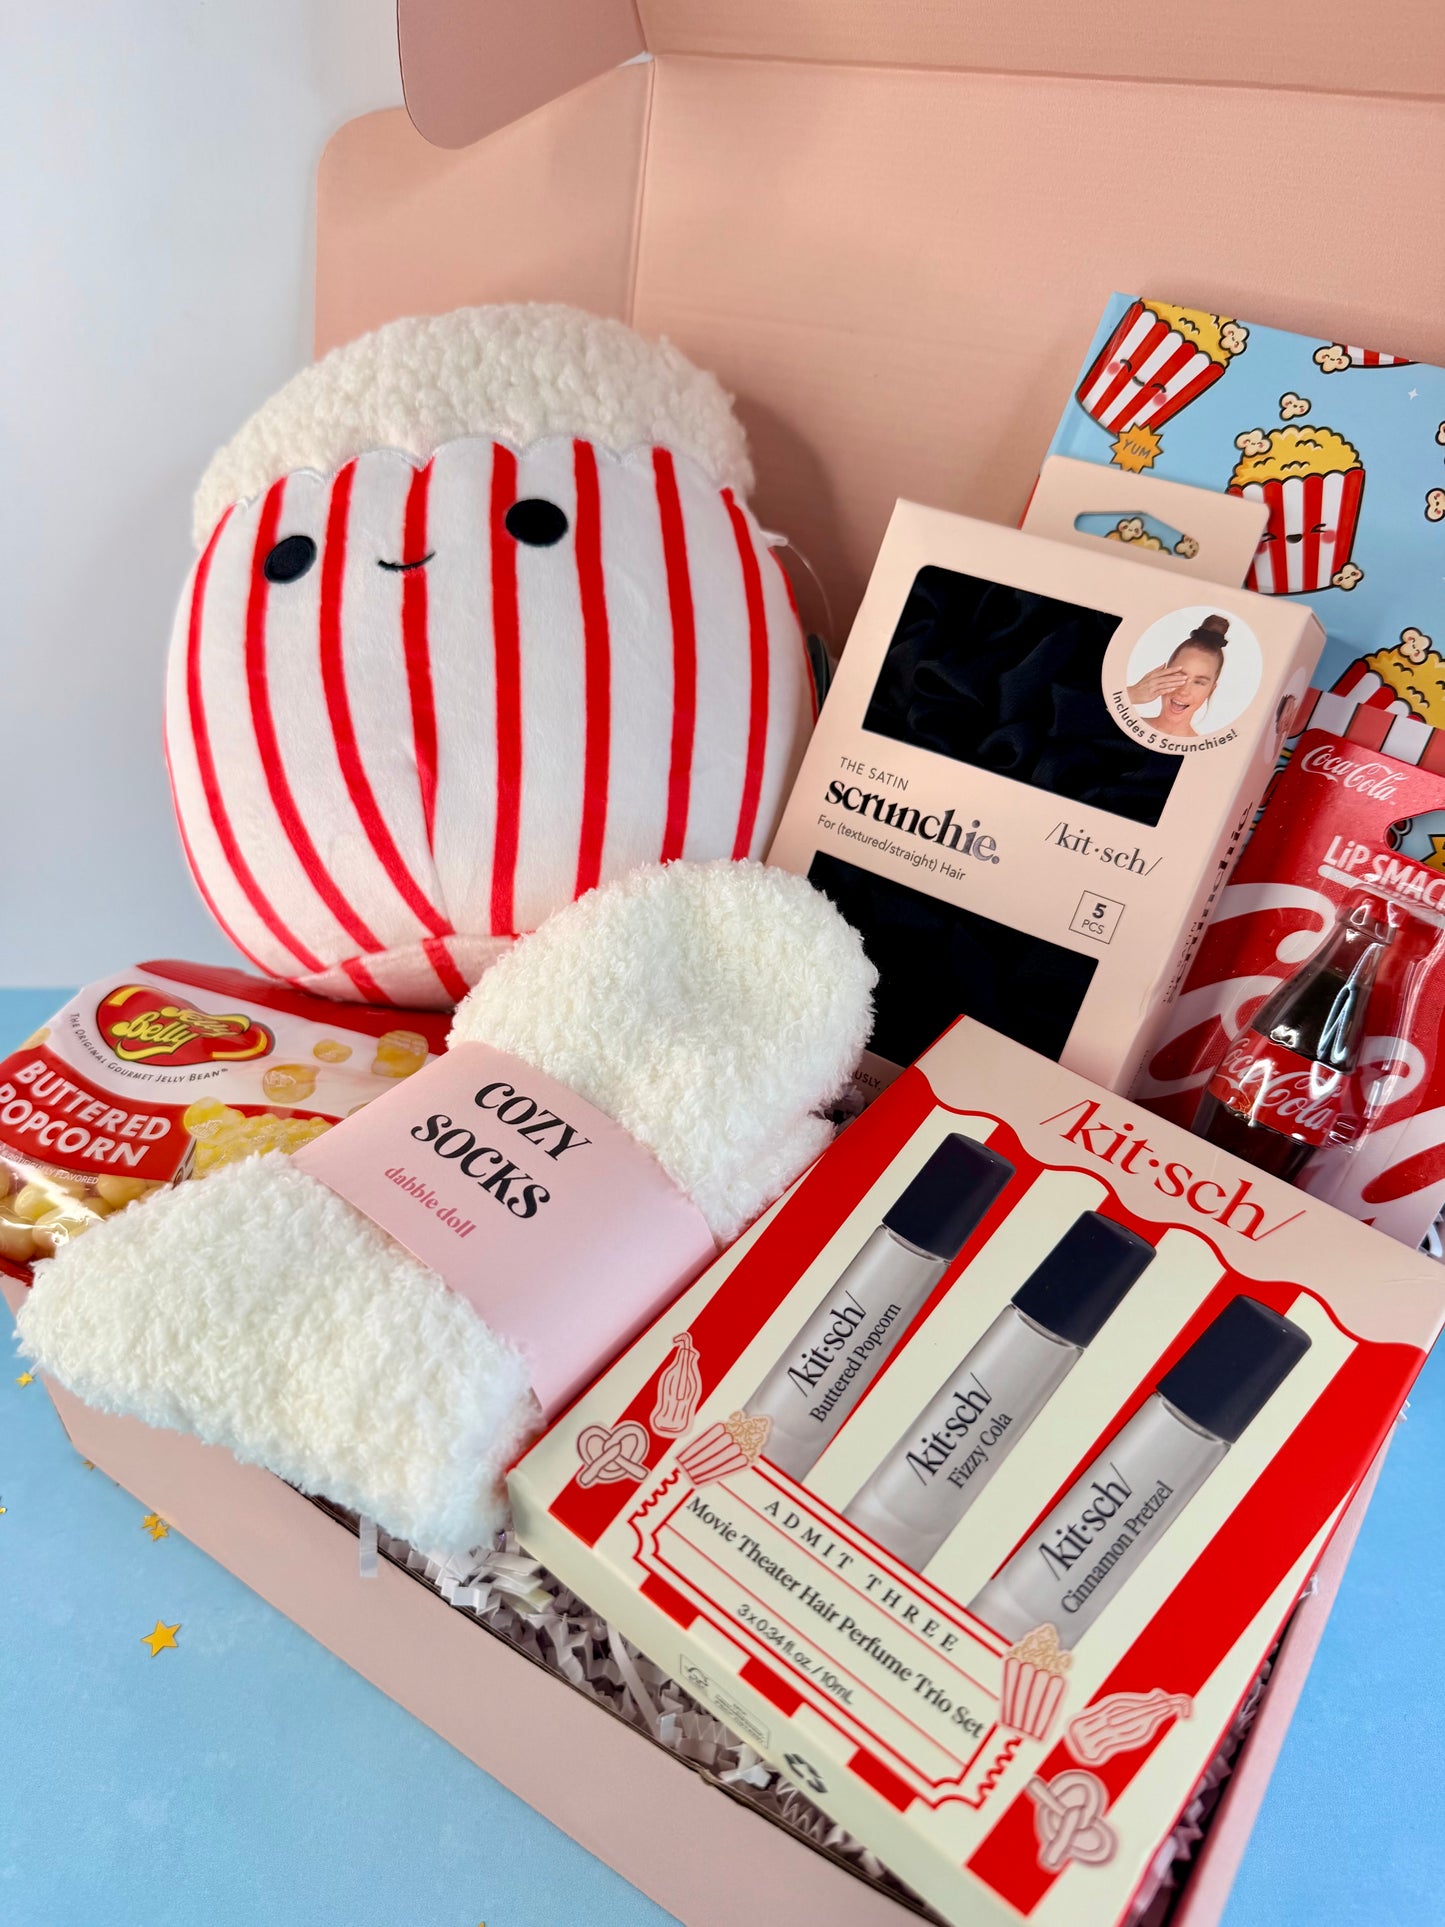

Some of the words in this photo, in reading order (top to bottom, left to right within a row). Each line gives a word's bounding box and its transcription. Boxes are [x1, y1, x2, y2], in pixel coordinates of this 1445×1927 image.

[1123, 439, 1151, 459] YUM
[1112, 690, 1145, 738] Includes
[1147, 733, 1157, 744] 5
[1159, 728, 1238, 752] Scrunchies!
[840, 756, 866, 775] THE
[868, 767, 910, 791] SATIN
[817, 814, 836, 831] For
[838, 822, 938, 872] (textured/straight)
[939, 862, 966, 881] Hair
[825, 780, 1000, 865] scrunchie.
[1081, 919, 1105, 934] PCS
[1092, 903, 1107, 919] 5
[70, 1013, 82, 1028] THE
[75, 1029, 107, 1064] ORIGINAL
[111, 1011, 200, 1061] Belly
[15, 1060, 171, 1140] BUTTERED
[107, 1062, 154, 1082] GOURMET
[155, 1074, 186, 1083] JELLY
[0, 1083, 149, 1167] POPCORN
[474, 1082, 593, 1161] COZY
[54, 1168, 99, 1184] FLAVORED
[410, 1114, 551, 1219] SOCKS
[384, 1167, 440, 1209] dabble
[436, 1207, 477, 1239] doll
[809, 1357, 862, 1424] Buttered
[853, 1302, 902, 1360] Popcorn
[947, 1445, 990, 1489] Fizzy
[980, 1412, 1013, 1447] Cola
[764, 1500, 854, 1570] ADMIT
[864, 1573, 959, 1651] THREE
[1061, 1533, 1133, 1614] Cinnamon
[1123, 1480, 1174, 1537] Pretzel
[686, 1497, 737, 1542] Movie
[737, 1534, 801, 1592] Theater
[798, 1585, 840, 1622] Hair
[837, 1616, 912, 1681] Perfume
[913, 1673, 952, 1713] Trio
[951, 1706, 985, 1739] Set
